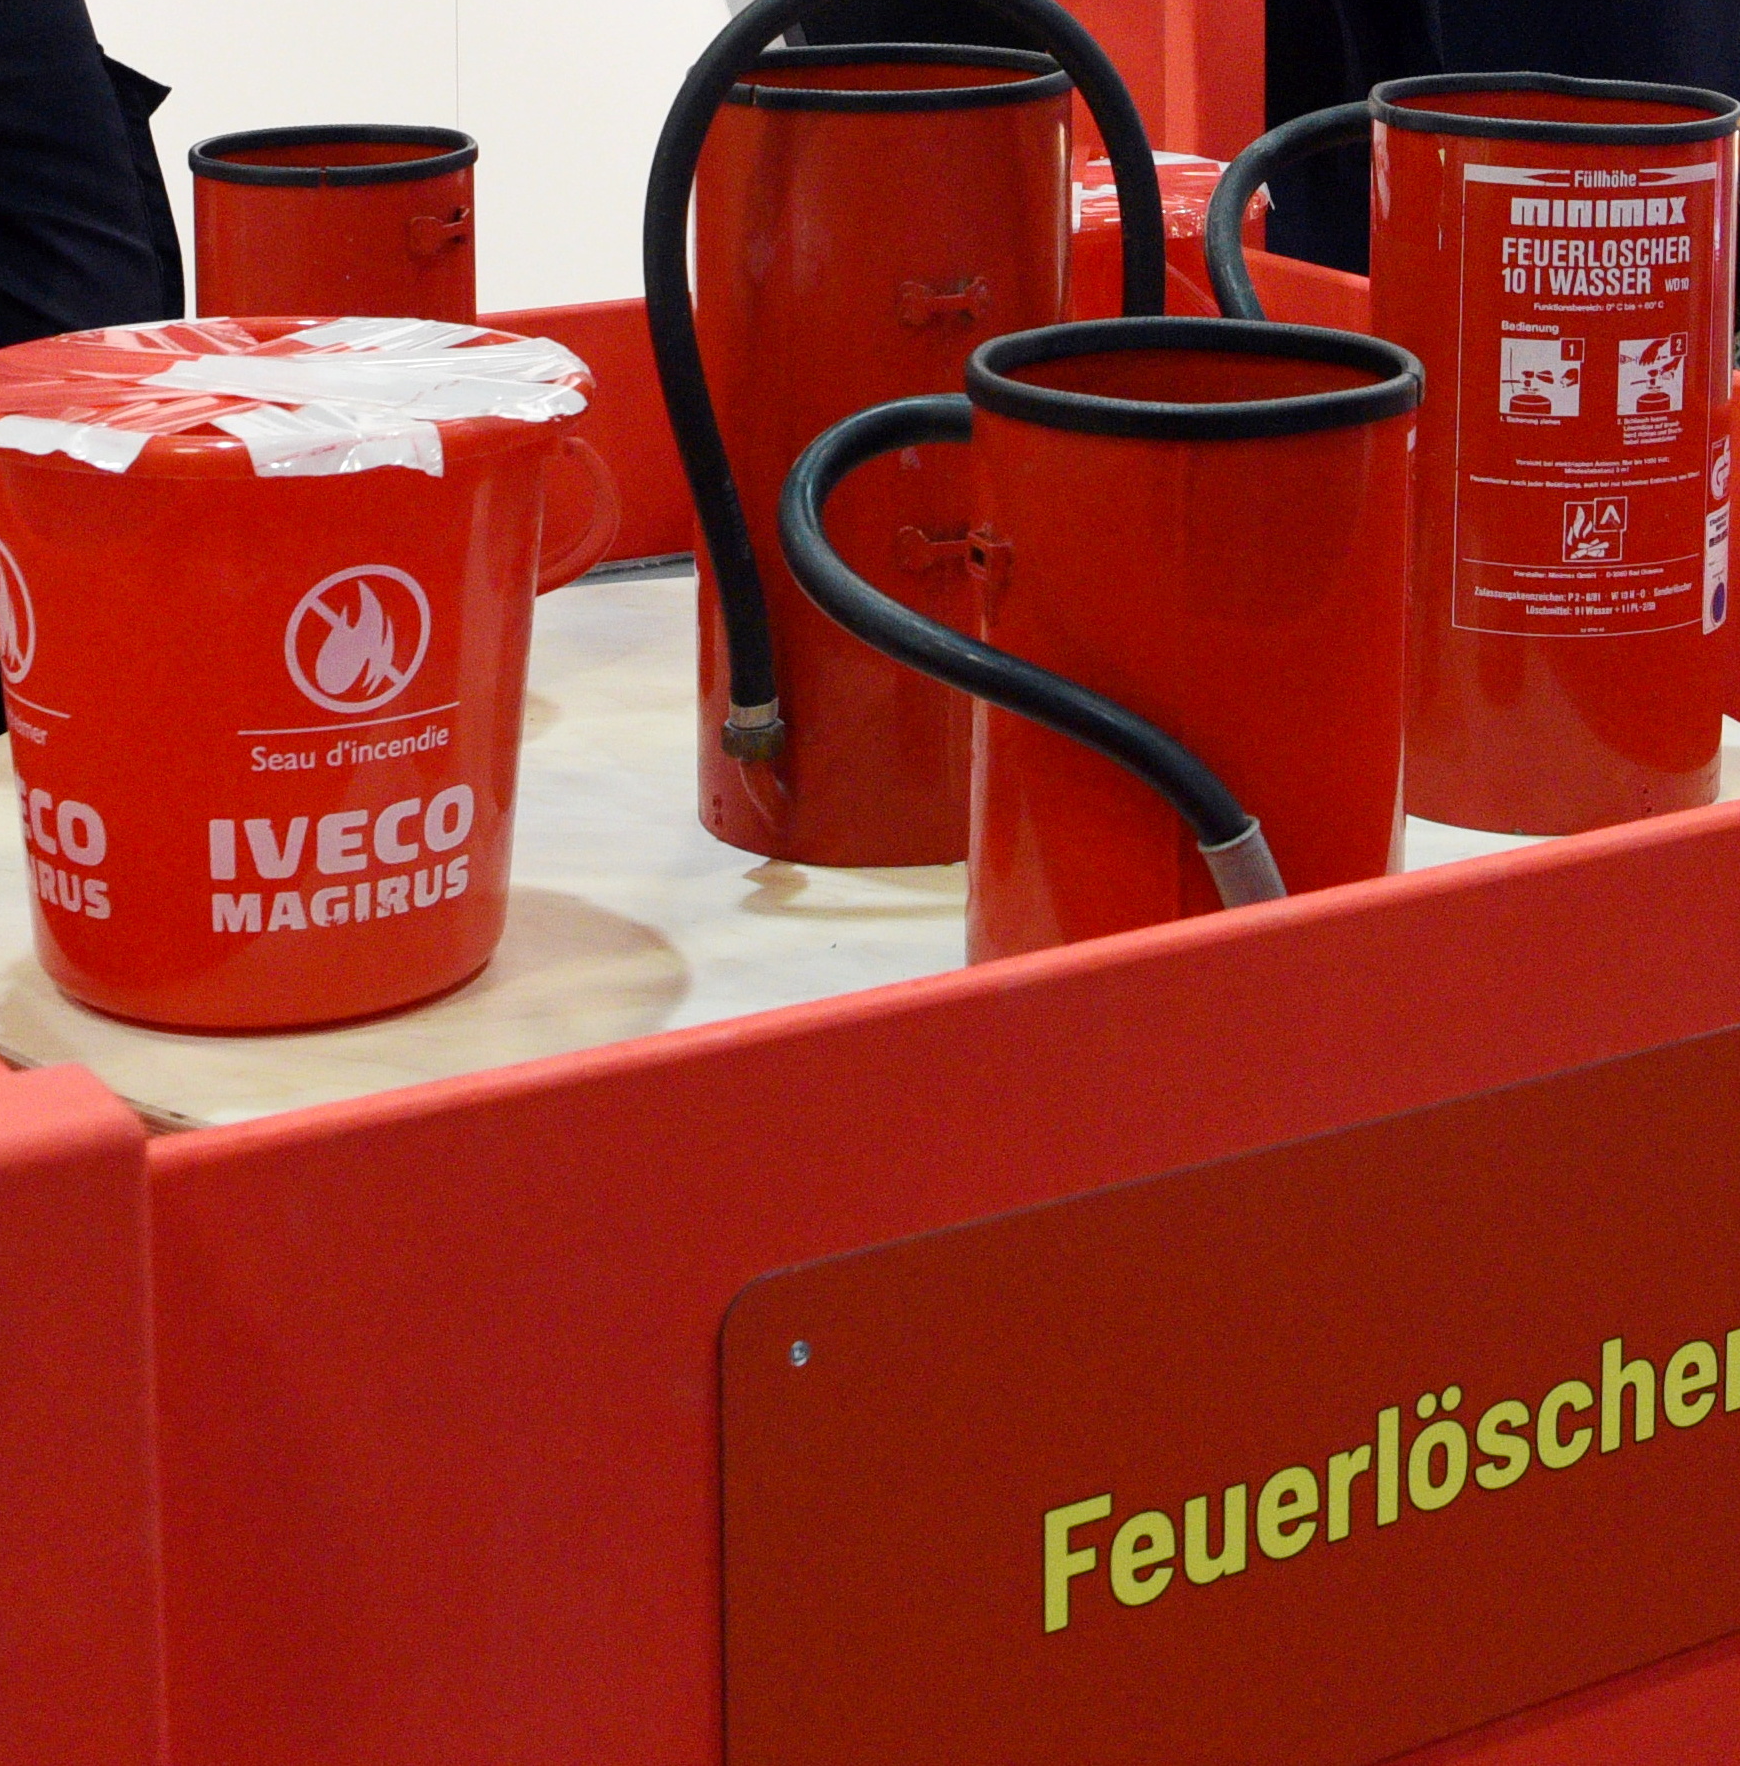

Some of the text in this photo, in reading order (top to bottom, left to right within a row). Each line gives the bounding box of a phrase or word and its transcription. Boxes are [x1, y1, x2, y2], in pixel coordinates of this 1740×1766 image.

[1574, 170, 1637, 188] Füllhöhe
[1510, 196, 1687, 228] minimax
[1501, 267, 1527, 294] 10
[1549, 267, 1652, 296] WASSER
[1501, 320, 1559, 335] Bedienung
[1568, 338, 1683, 357] 1 2
[251, 746, 316, 772] Seau
[209, 783, 475, 882] IVECO
[211, 854, 470, 933] MAGIRUS
